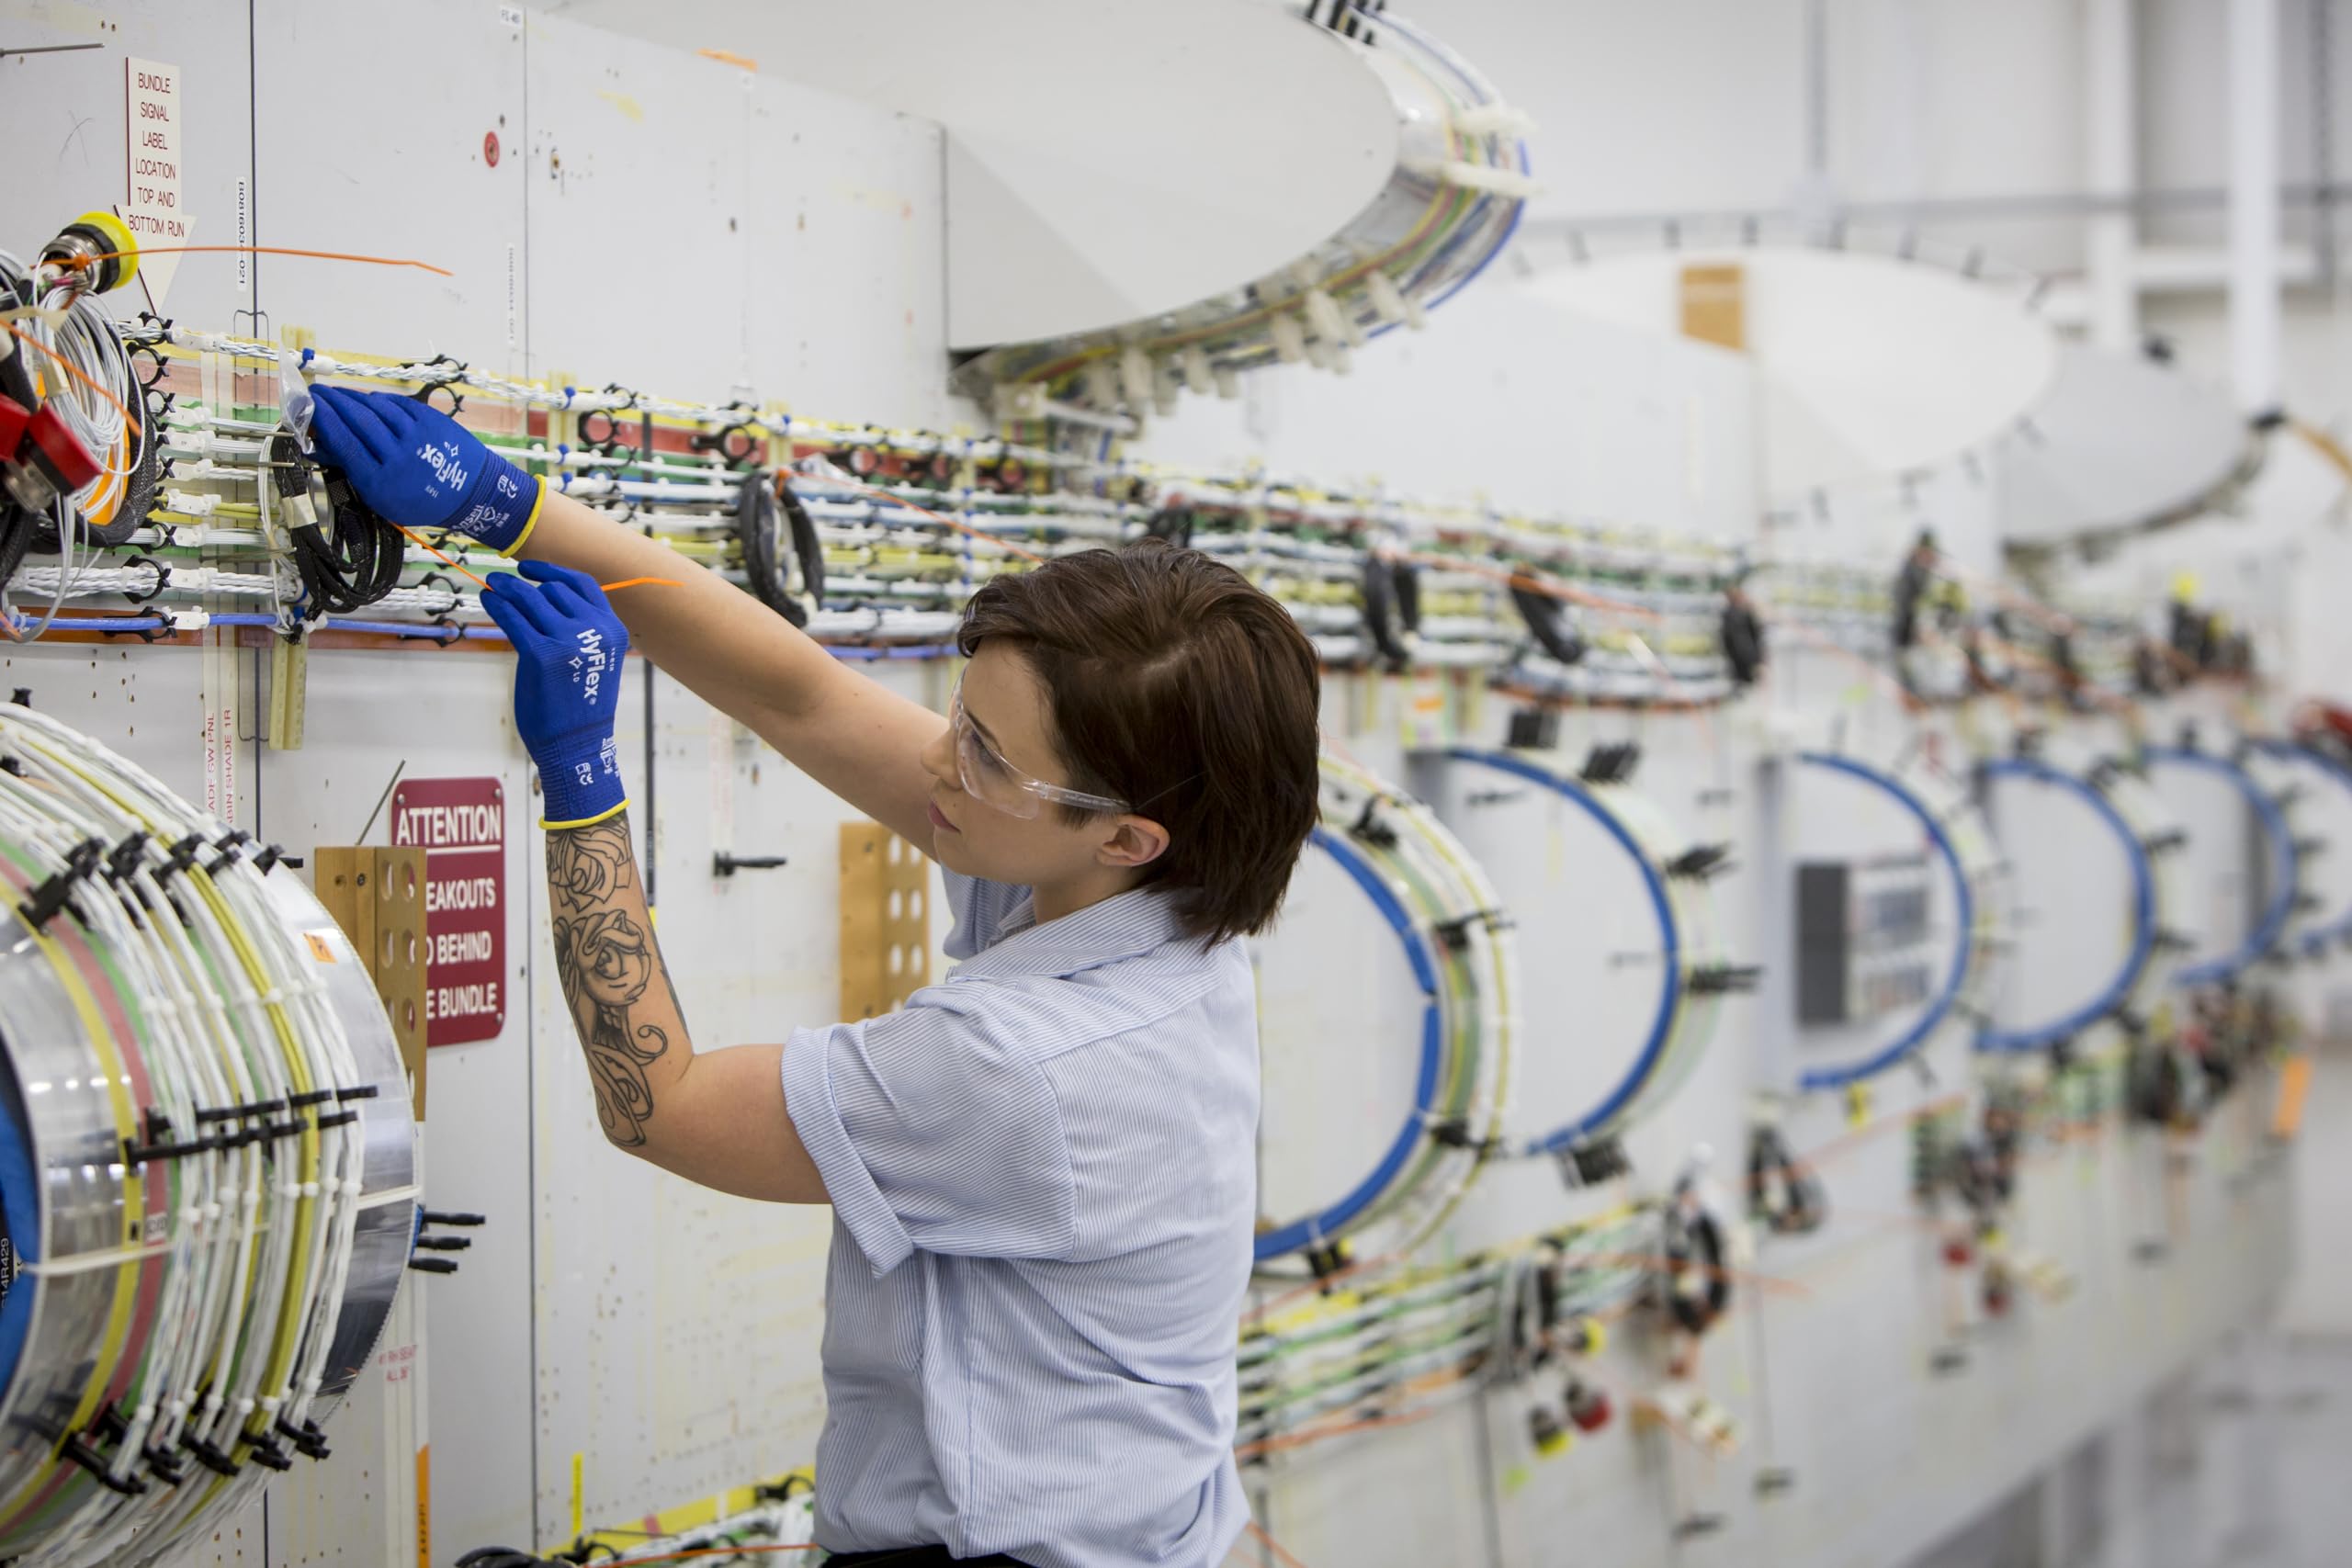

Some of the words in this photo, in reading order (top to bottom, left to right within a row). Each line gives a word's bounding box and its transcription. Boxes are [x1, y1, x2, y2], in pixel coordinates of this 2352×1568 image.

[138, 73, 171, 94] BUNDLE
[140, 102, 169, 122] SIGNAL
[142, 130, 168, 150] LABEL
[136, 158, 175, 180] LOCATION
[138, 186, 154, 204] TOP
[157, 190, 175, 208] AND
[129, 214, 164, 235] BOTTOM
[168, 220, 185, 238] RUN
[420, 443, 469, 491] HyFlex
[576, 627, 606, 699] HyFlex
[207, 713, 215, 742] PNL
[223, 709, 232, 728] 1R
[208, 748, 215, 773] SW
[224, 734, 233, 788] SHADE
[208, 778, 216, 812] ADE
[396, 805, 502, 846] ATTENTION
[425, 877, 496, 911] EAKOUTS
[436, 930, 492, 964] BEHIND
[438, 982, 497, 1019] BUNDLE
